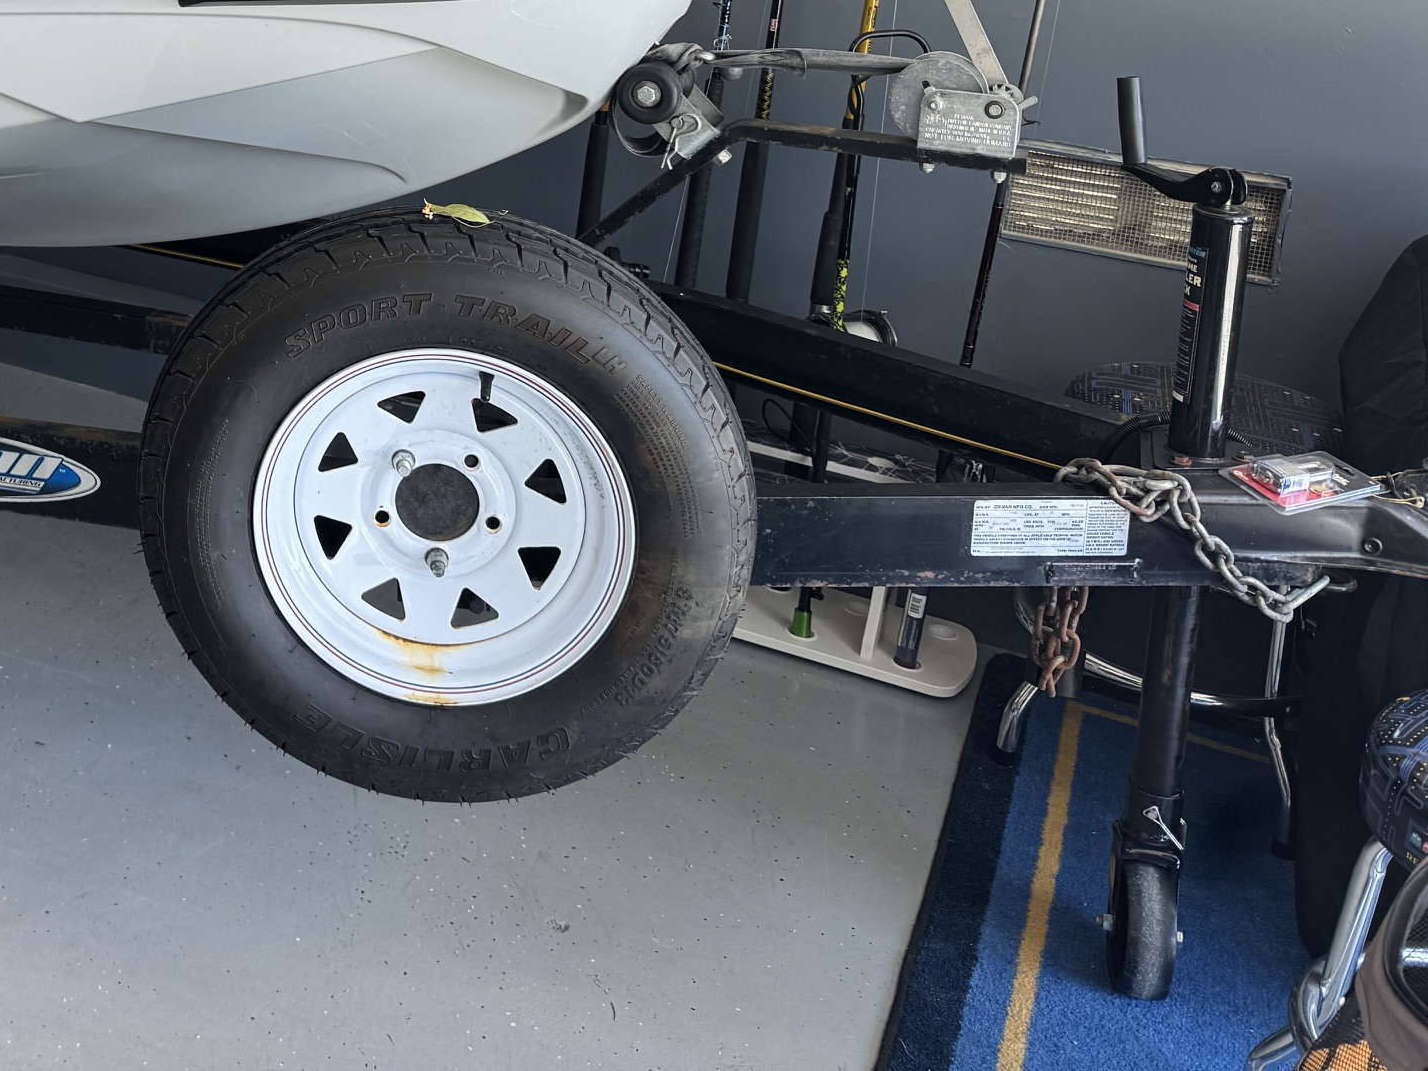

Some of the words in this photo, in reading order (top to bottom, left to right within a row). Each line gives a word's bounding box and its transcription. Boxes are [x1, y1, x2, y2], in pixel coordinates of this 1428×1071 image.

[956, 136, 981, 144] MOVING
[284, 292, 433, 359] SPORT
[455, 294, 591, 365] TRAIL
[635, 374, 664, 406] SAFETY
[292, 703, 570, 772] CARLISLE
